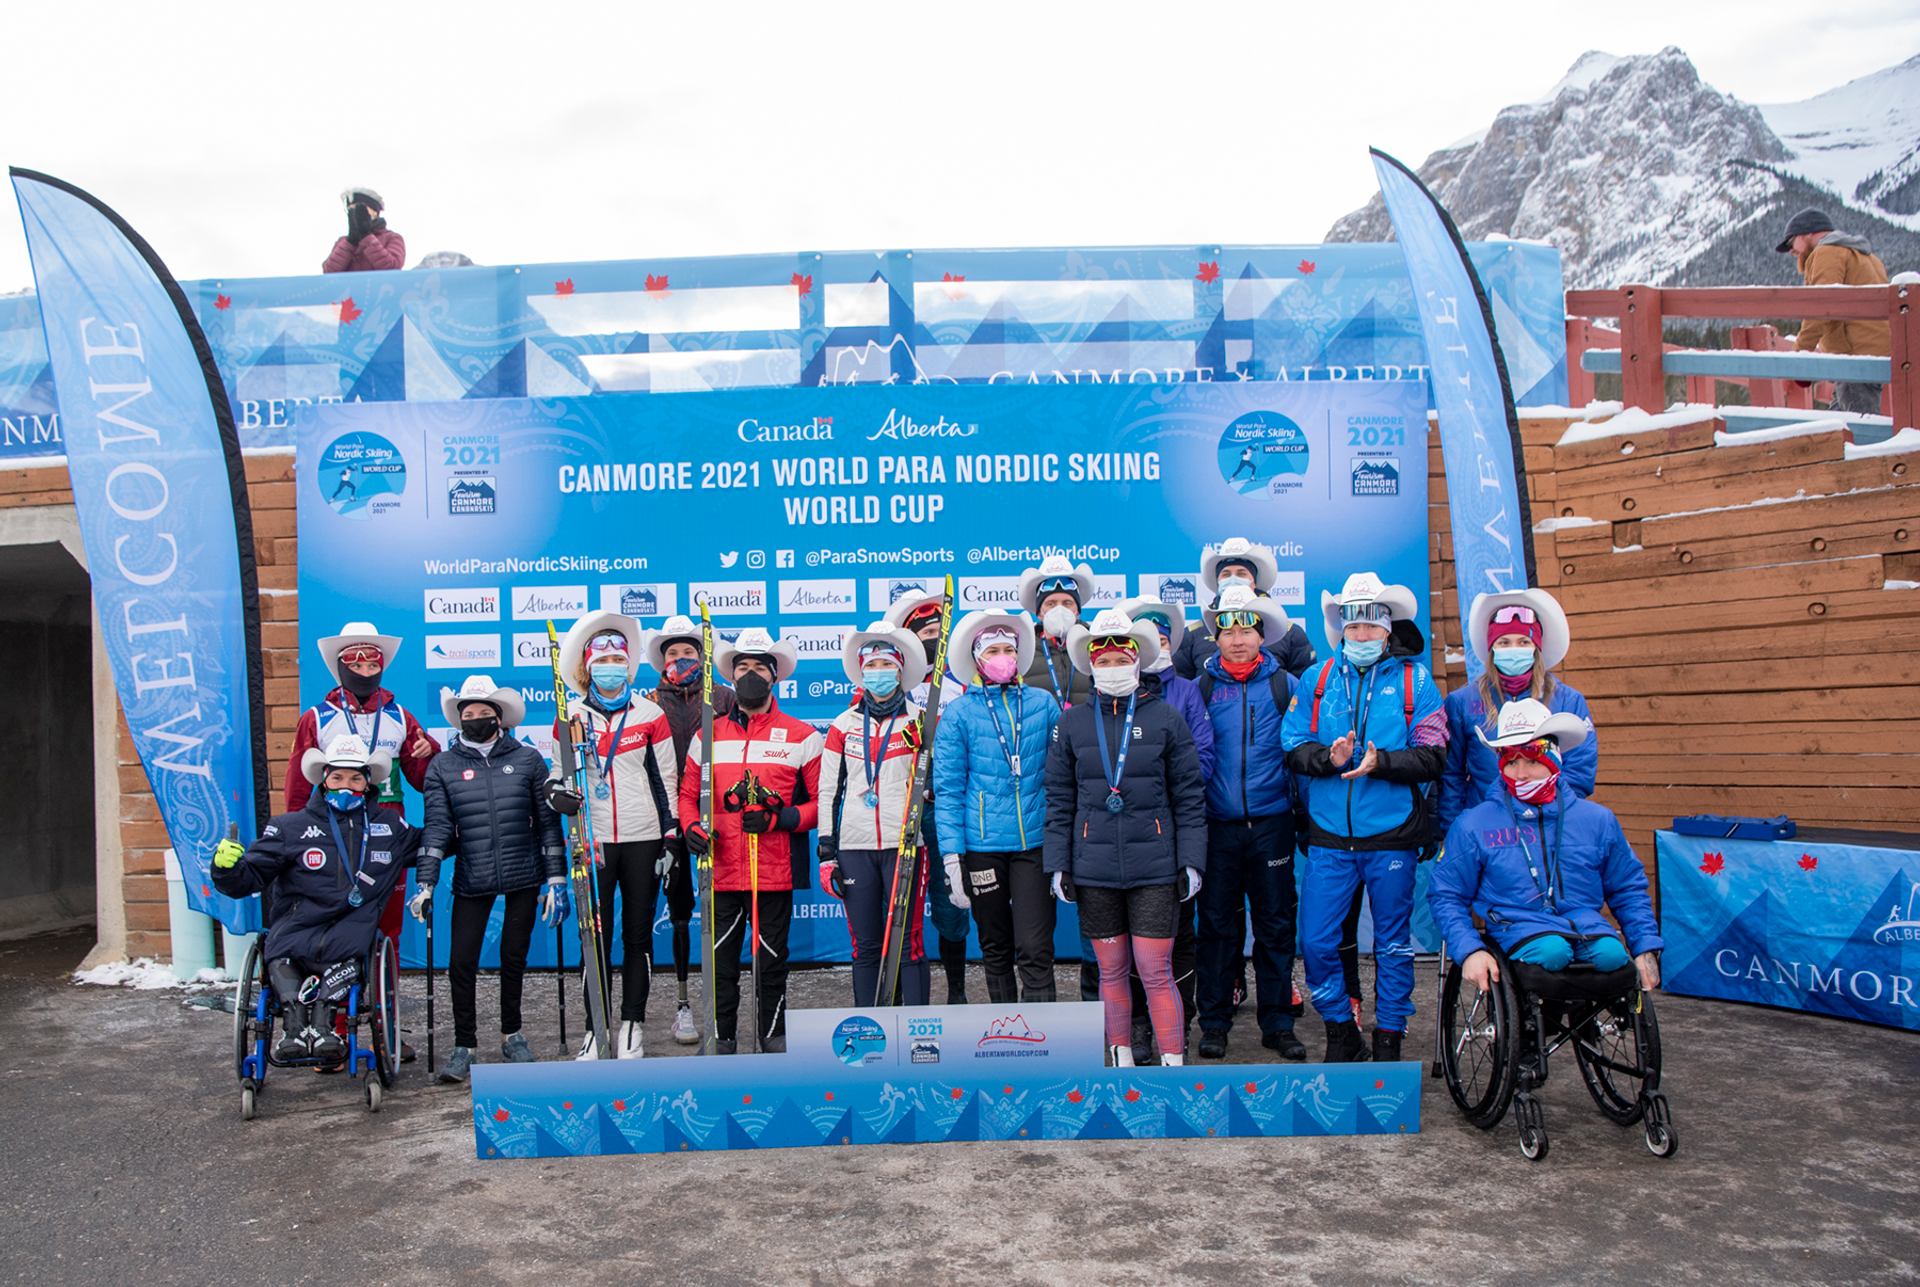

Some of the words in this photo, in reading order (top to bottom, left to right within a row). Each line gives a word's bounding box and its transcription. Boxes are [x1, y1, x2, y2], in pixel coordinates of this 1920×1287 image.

[738, 417, 833, 442] Canada
[866, 408, 975, 440] Alberta
[1347, 416, 1404, 425] CANMORE
[443, 435, 500, 445] CANMORE
[1235, 428, 1265, 438] Nordic
[1267, 428, 1296, 439] Skiing
[1347, 427, 1405, 446] 2021
[334, 449, 363, 459] Nordic
[366, 449, 393, 459] Skiing
[443, 446, 500, 466] 2021
[1264, 445, 1290, 453] WORLD
[1290, 445, 1305, 453] CUP
[363, 465, 387, 473] WORLD
[388, 465, 402, 473] CUP
[559, 462, 692, 493] CANMORE
[701, 461, 760, 488] 2021
[772, 456, 868, 486] WORLD
[879, 455, 946, 484] PARA
[956, 454, 1059, 483] NORDIC
[1069, 452, 1160, 481] SKIING
[1354, 470, 1384, 479] Tourism
[1354, 479, 1397, 487] CANMORE
[451, 498, 493, 506] CANMORE
[784, 496, 880, 525] WORLD
[890, 494, 944, 523] CUP
[805, 548, 954, 566] @ParaSnowSports
[967, 544, 1120, 563] @AlbertaWorldCup
[424, 556, 648, 575] WorldParaNordicSkiing.com
[694, 590, 761, 607] Canada
[784, 587, 842, 607] Alberta
[963, 584, 1020, 601] Canad
[429, 597, 495, 614] Canada
[518, 594, 576, 613] Alberta
[933, 602, 953, 688] FISCHER
[703, 627, 712, 705] FISCHER
[551, 648, 568, 722] FISCHER
[1484, 825, 1537, 848] RUS
[972, 872, 993, 883] DNB
[326, 966, 355, 985] RICOH
[1715, 949, 1919, 1008] CANMOR
[908, 1024, 943, 1036] 2021
[974, 1050, 1049, 1058] ALBERTAWORLDCUP.COM
